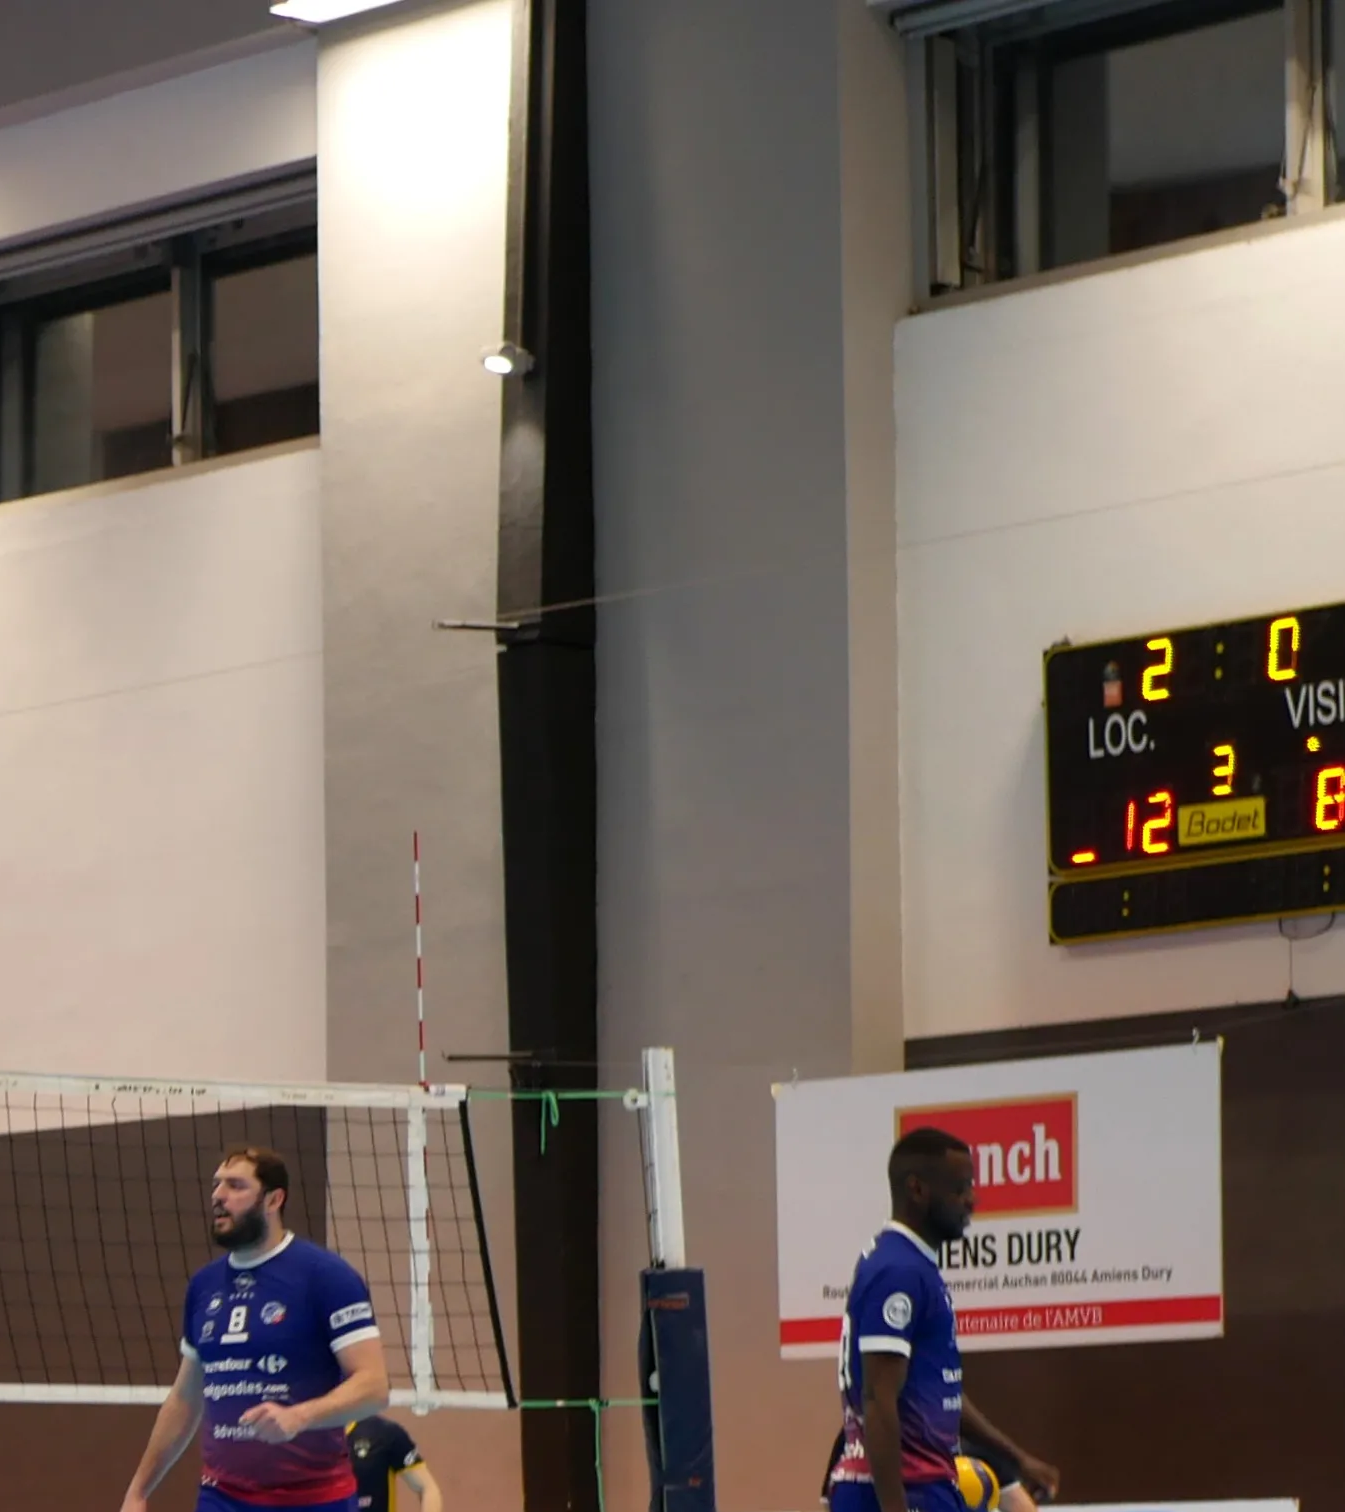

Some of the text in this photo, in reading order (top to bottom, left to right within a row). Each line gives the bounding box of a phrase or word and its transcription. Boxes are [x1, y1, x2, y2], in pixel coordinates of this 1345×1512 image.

[1141, 616, 1300, 702] 2 0
[1087, 708, 1155, 760] LOC.
[1212, 744, 1235, 796] 3
[1125, 791, 1173, 854] 12
[1184, 808, 1260, 839] Bodet
[973, 1121, 1063, 1188] nch
[937, 1226, 1082, 1270] IENS DURY
[1001, 1272, 1048, 1290] Auchan
[1090, 1265, 1139, 1284] Amiens
[1141, 1264, 1173, 1283] Dury
[1023, 1309, 1041, 1329] de
